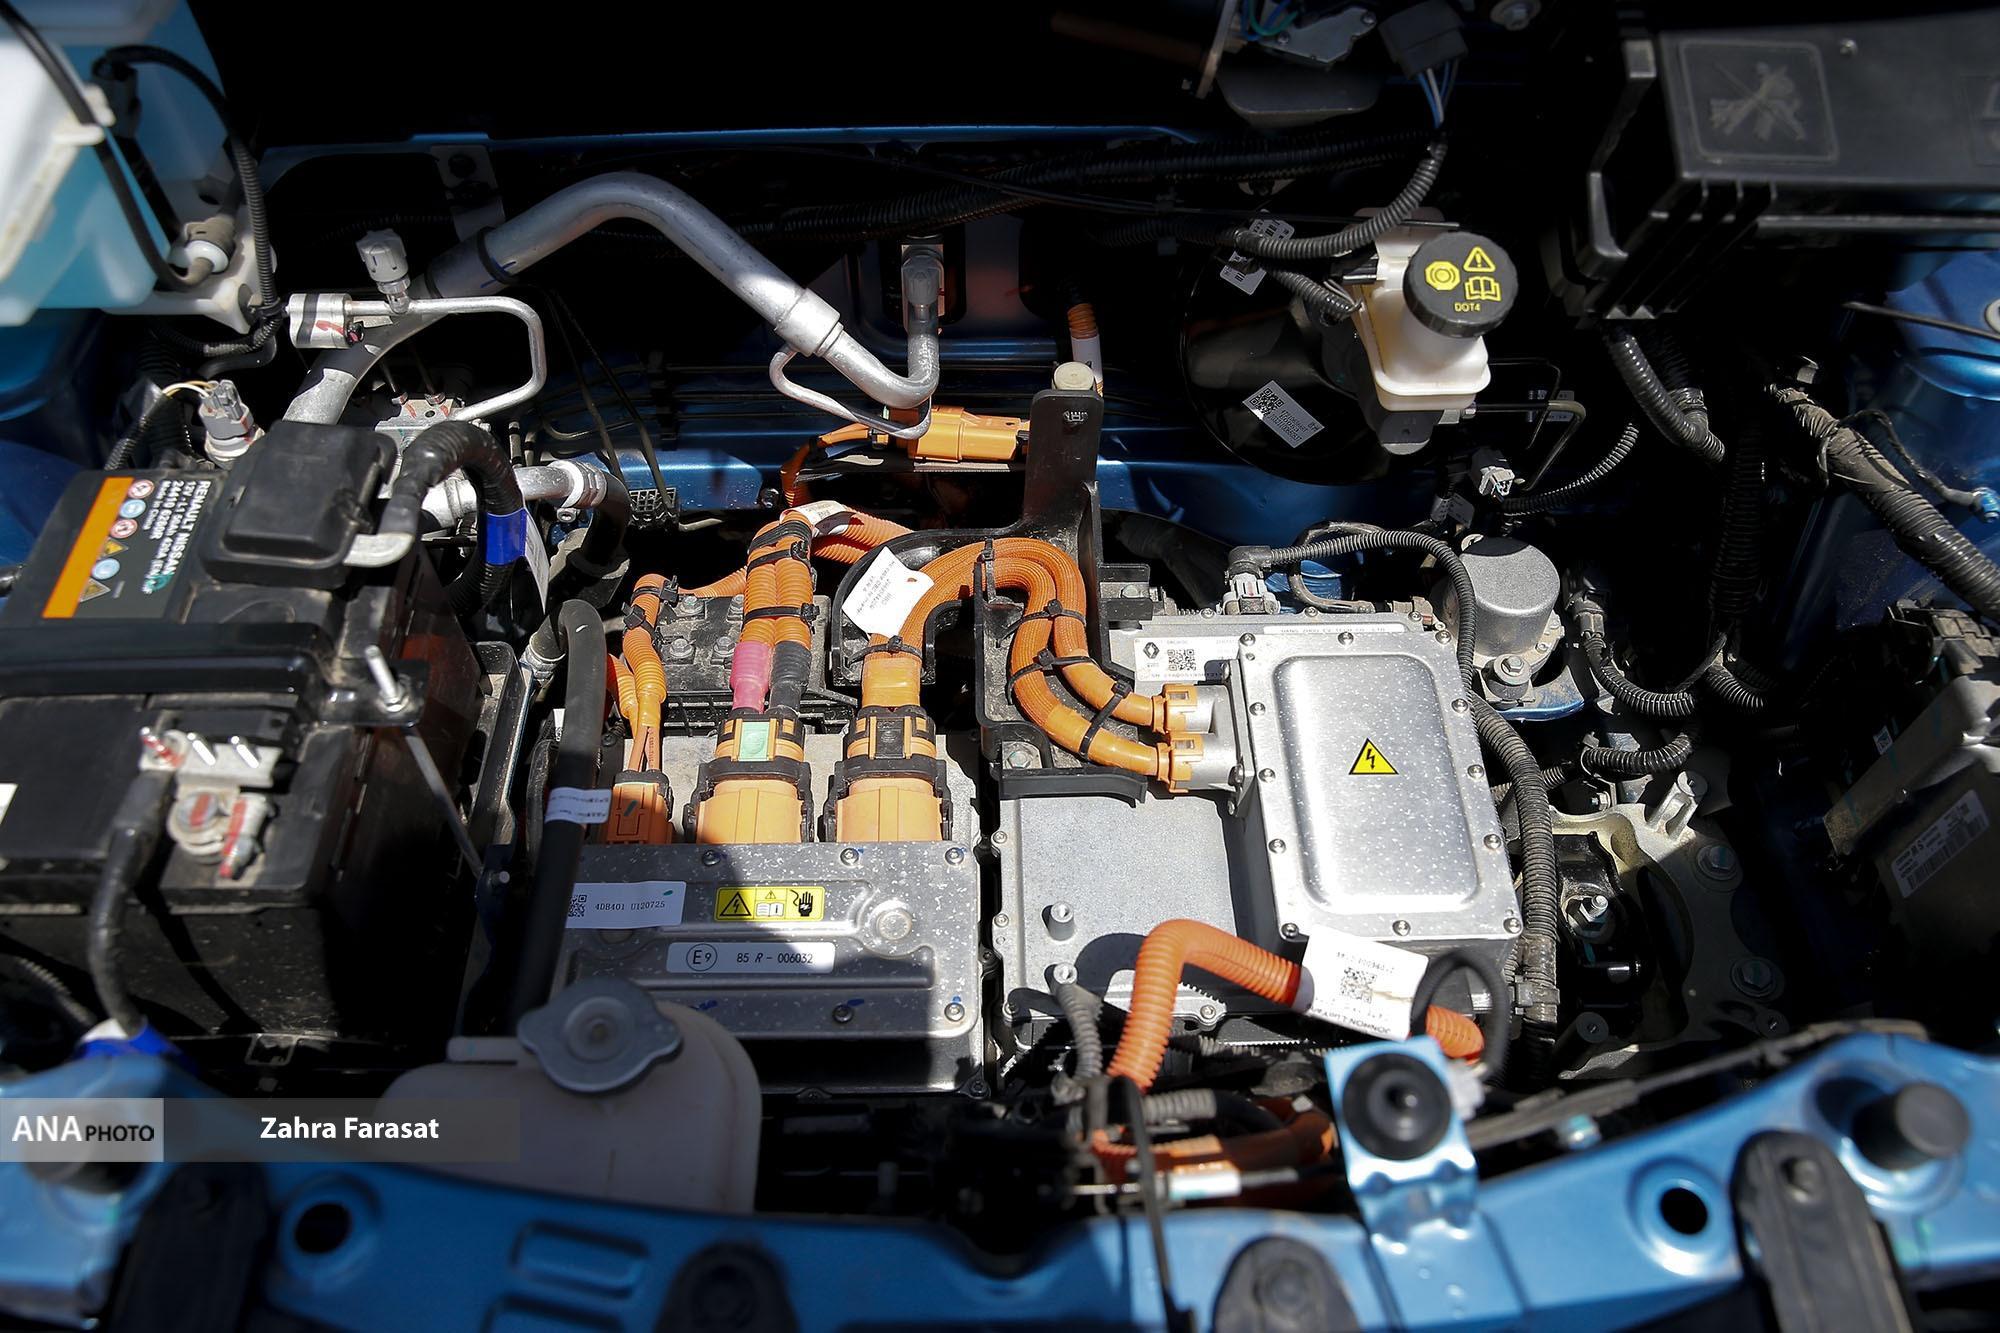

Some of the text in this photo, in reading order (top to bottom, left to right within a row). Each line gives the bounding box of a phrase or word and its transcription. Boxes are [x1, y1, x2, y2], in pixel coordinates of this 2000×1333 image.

[1454, 302, 1481, 312] DOT4
[182, 481, 196, 496] 12V
[162, 481, 211, 576] RENAULT NISSAN
[736, 952, 750, 963] 85
[754, 952, 764, 963] R
[777, 952, 813, 963] 006032
